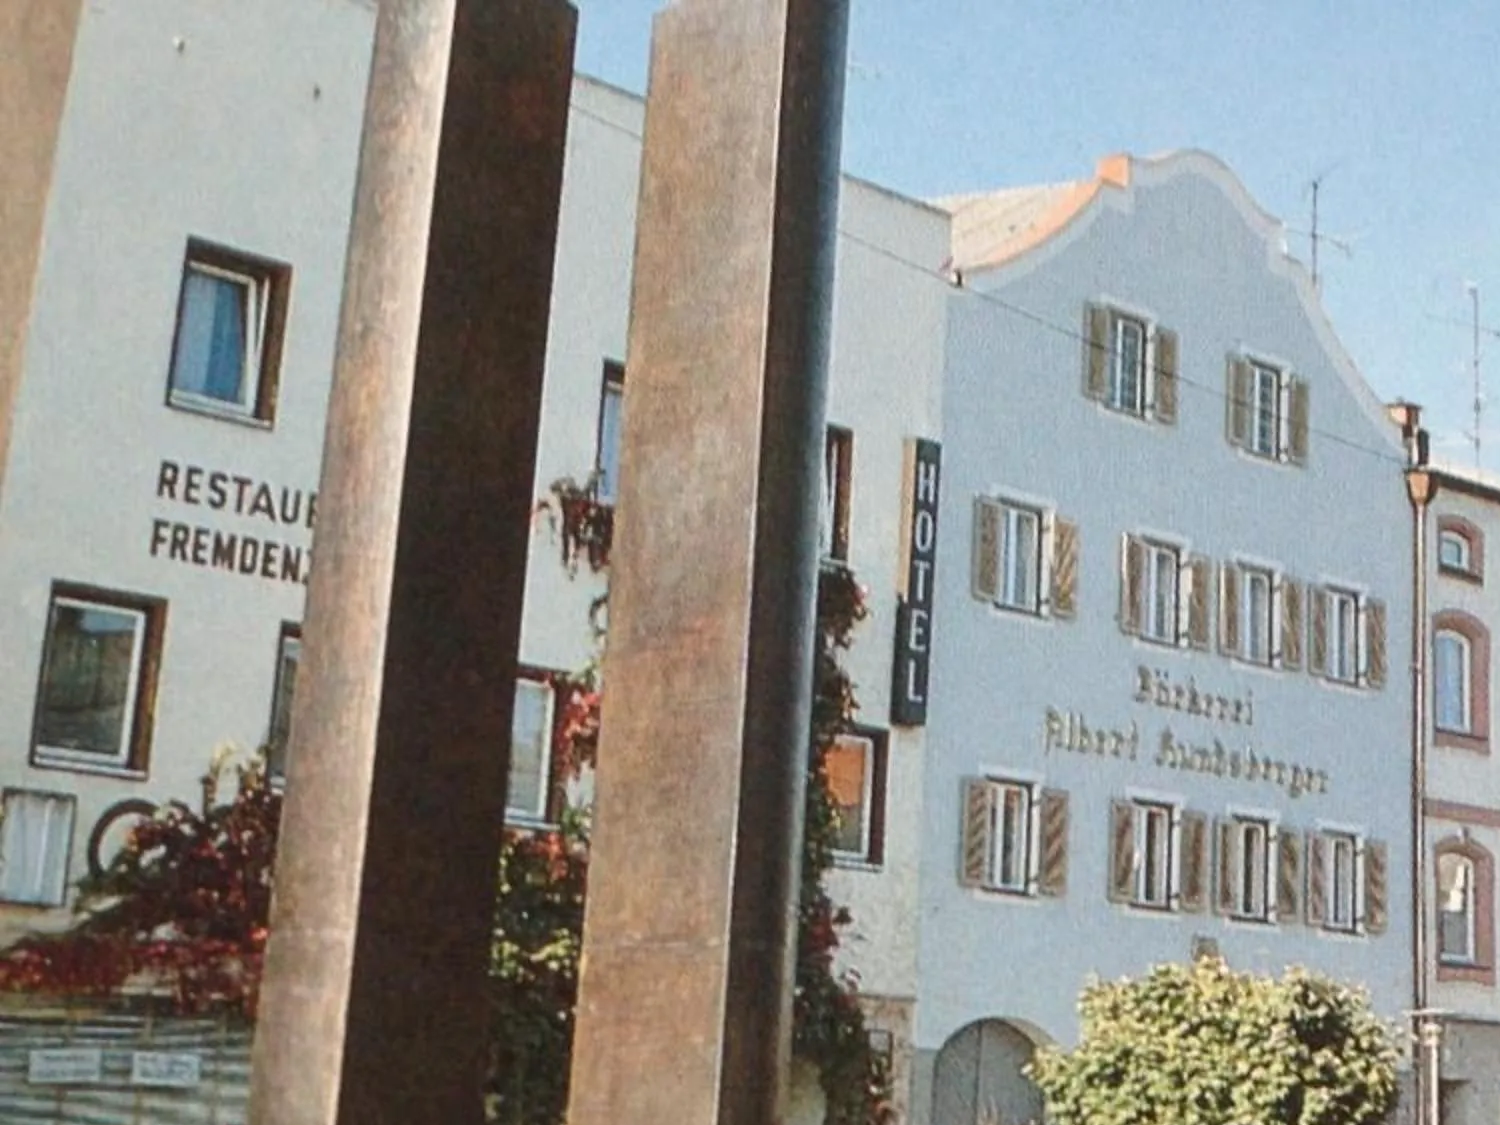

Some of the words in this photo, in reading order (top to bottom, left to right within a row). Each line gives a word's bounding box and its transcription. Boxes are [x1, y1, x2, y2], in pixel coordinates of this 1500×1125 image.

[150, 517, 312, 586] FREMDEN
[907, 460, 937, 704] HOTEL
[1133, 664, 1253, 726] Bäckerei
[1044, 704, 1139, 762] Albert
